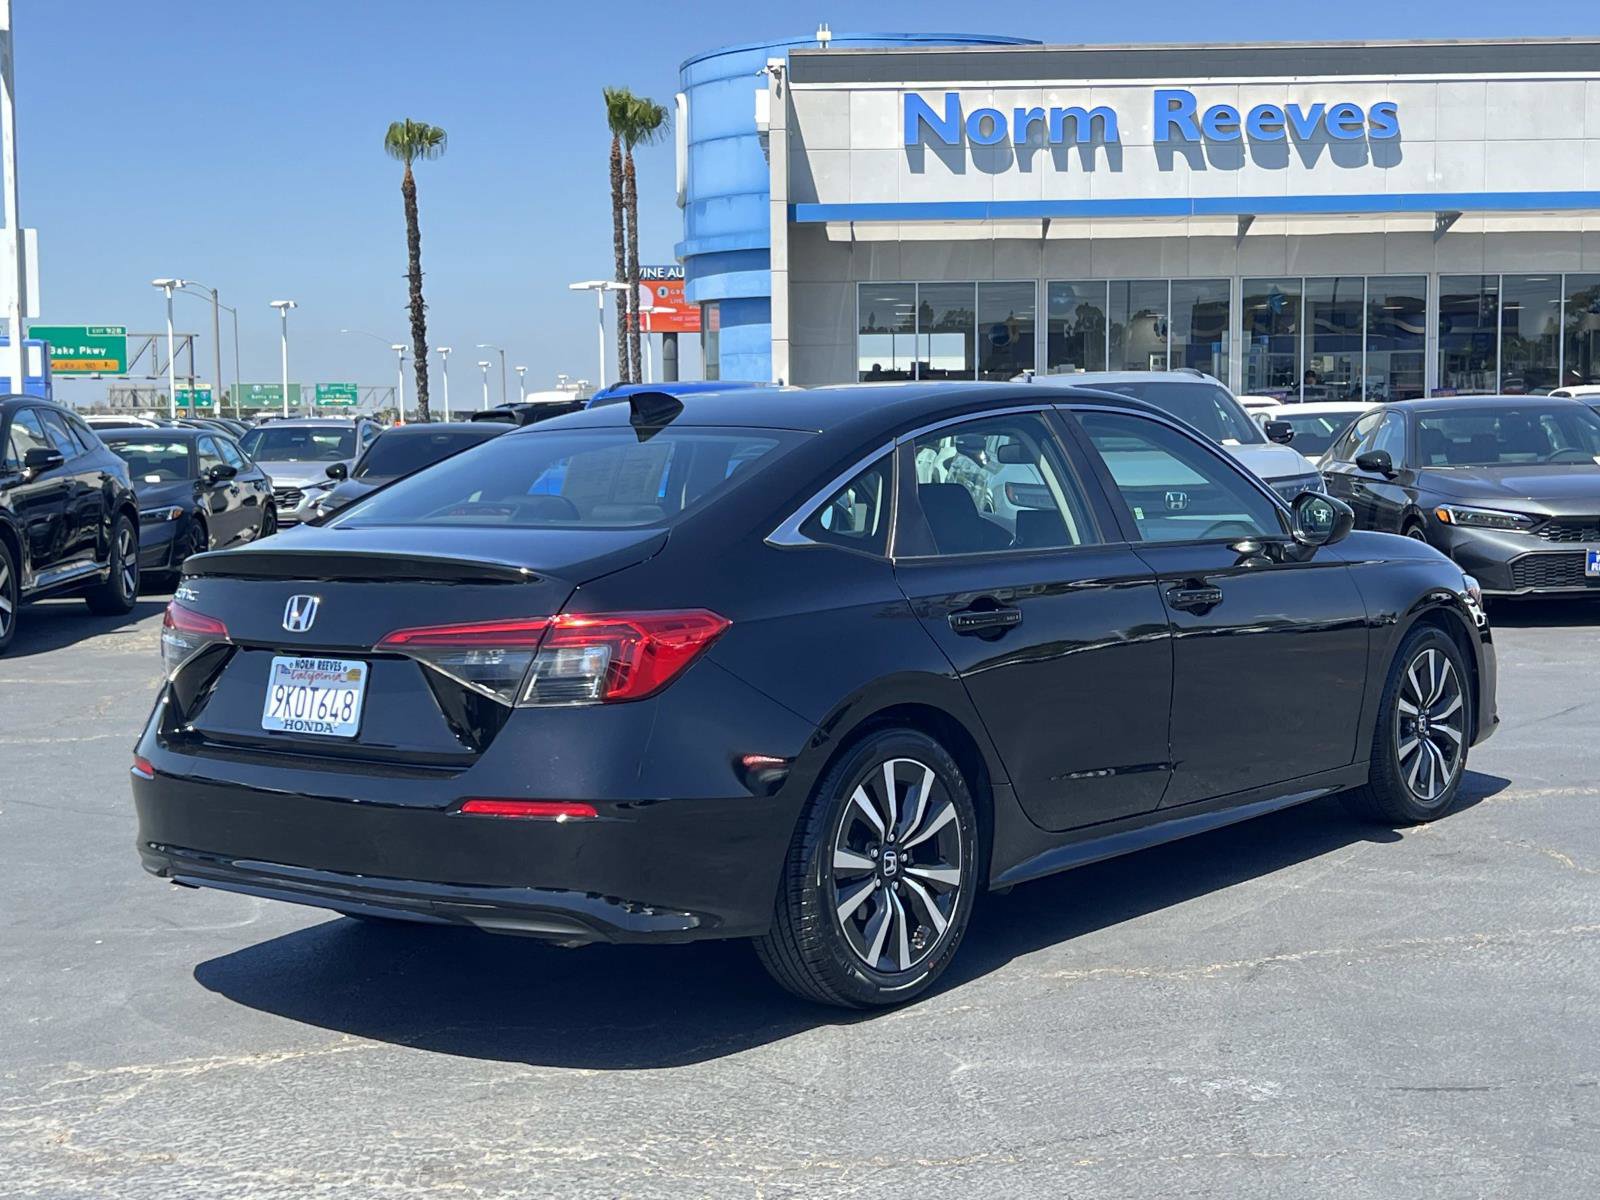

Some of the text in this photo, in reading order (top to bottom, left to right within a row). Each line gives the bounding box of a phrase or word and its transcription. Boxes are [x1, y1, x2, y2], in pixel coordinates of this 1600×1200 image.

[903, 89, 1399, 146] Norm Reeves
[79, 345, 107, 357] Pkwy
[294, 659, 342, 672] NORM REEVES
[290, 669, 343, 685] California
[283, 719, 335, 734] HONDA
